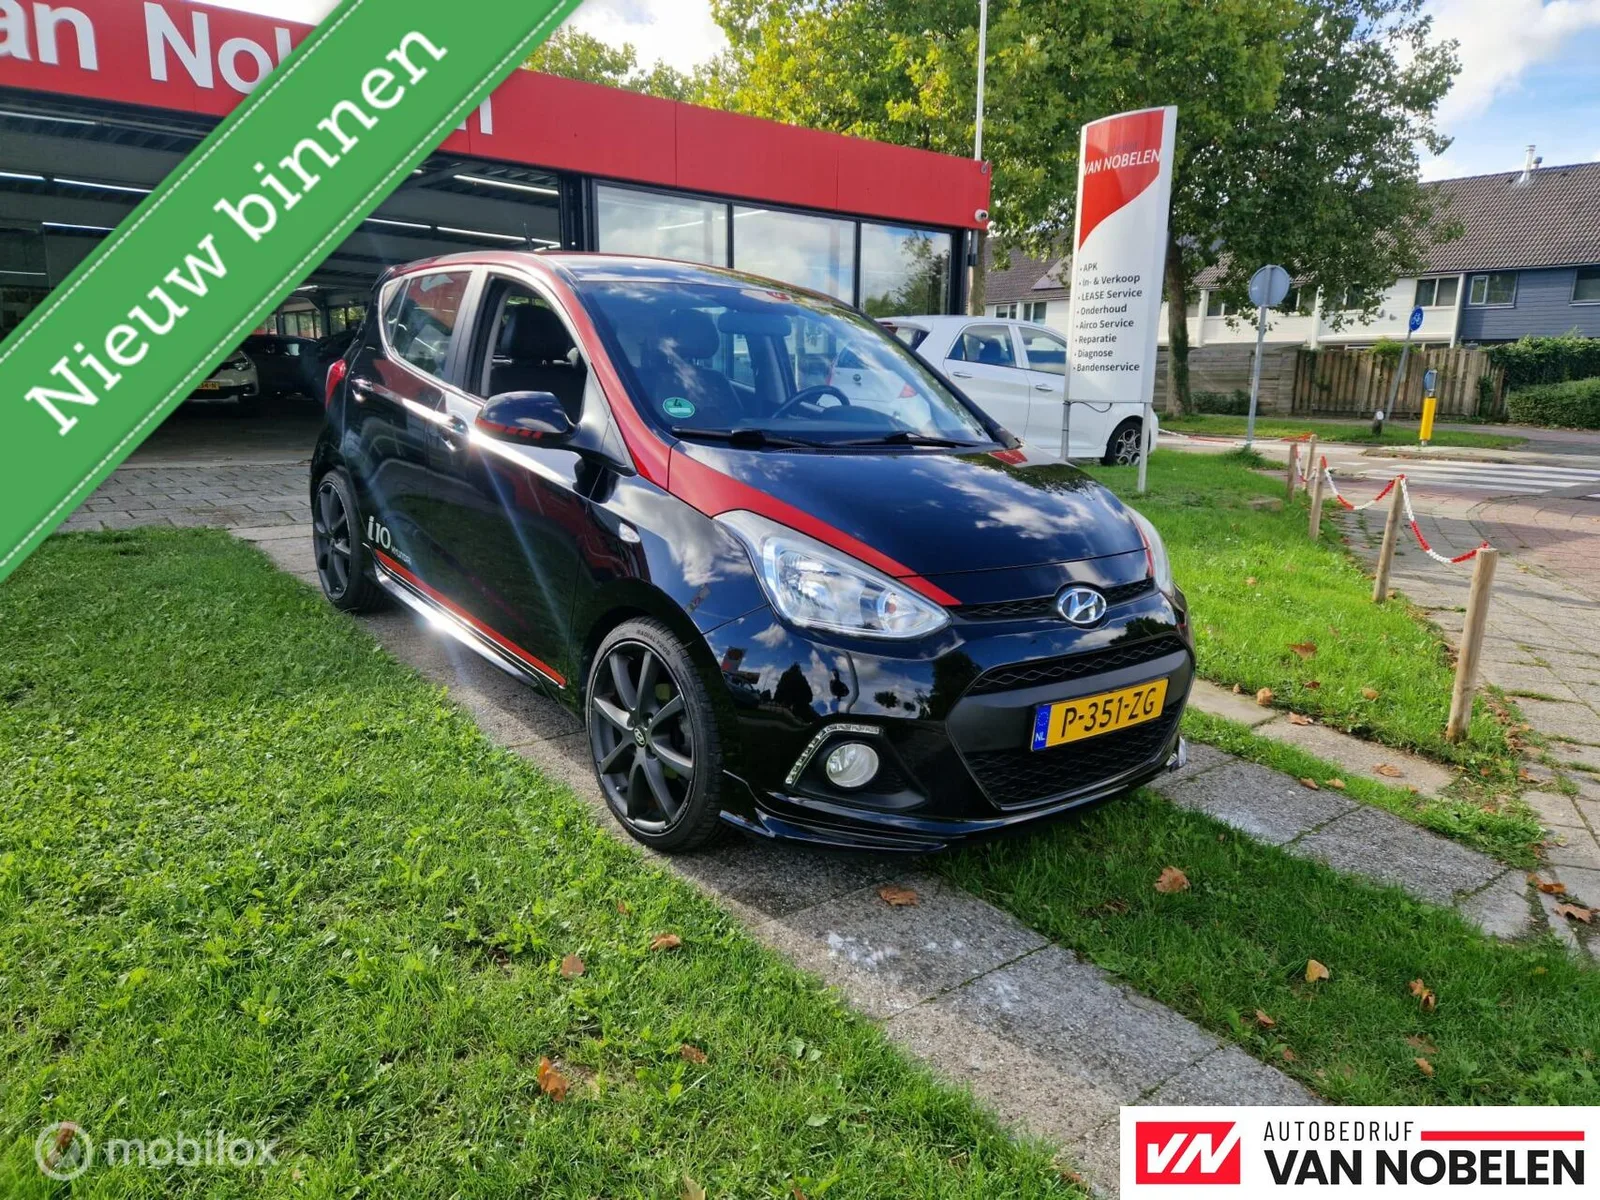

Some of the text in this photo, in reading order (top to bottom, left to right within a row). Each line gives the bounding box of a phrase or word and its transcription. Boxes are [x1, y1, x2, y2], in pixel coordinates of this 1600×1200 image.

[1084, 149, 1161, 175] VAN NOBELEN
[1083, 262, 1098, 272] APK
[1093, 276, 1100, 285] &
[1101, 274, 1141, 285] Verkoop
[1081, 288, 1143, 301] LEASE Service
[1080, 304, 1128, 315] Onderhoud
[1079, 318, 1135, 330] Airco Service
[1078, 333, 1118, 345] Reparatie
[1077, 348, 1114, 360] Diagnose
[1076, 362, 1141, 372] Bandenservice
[367, 515, 392, 549] i10
[1060, 687, 1157, 738] P-351-ZG
[1034, 731, 1046, 742] NL
